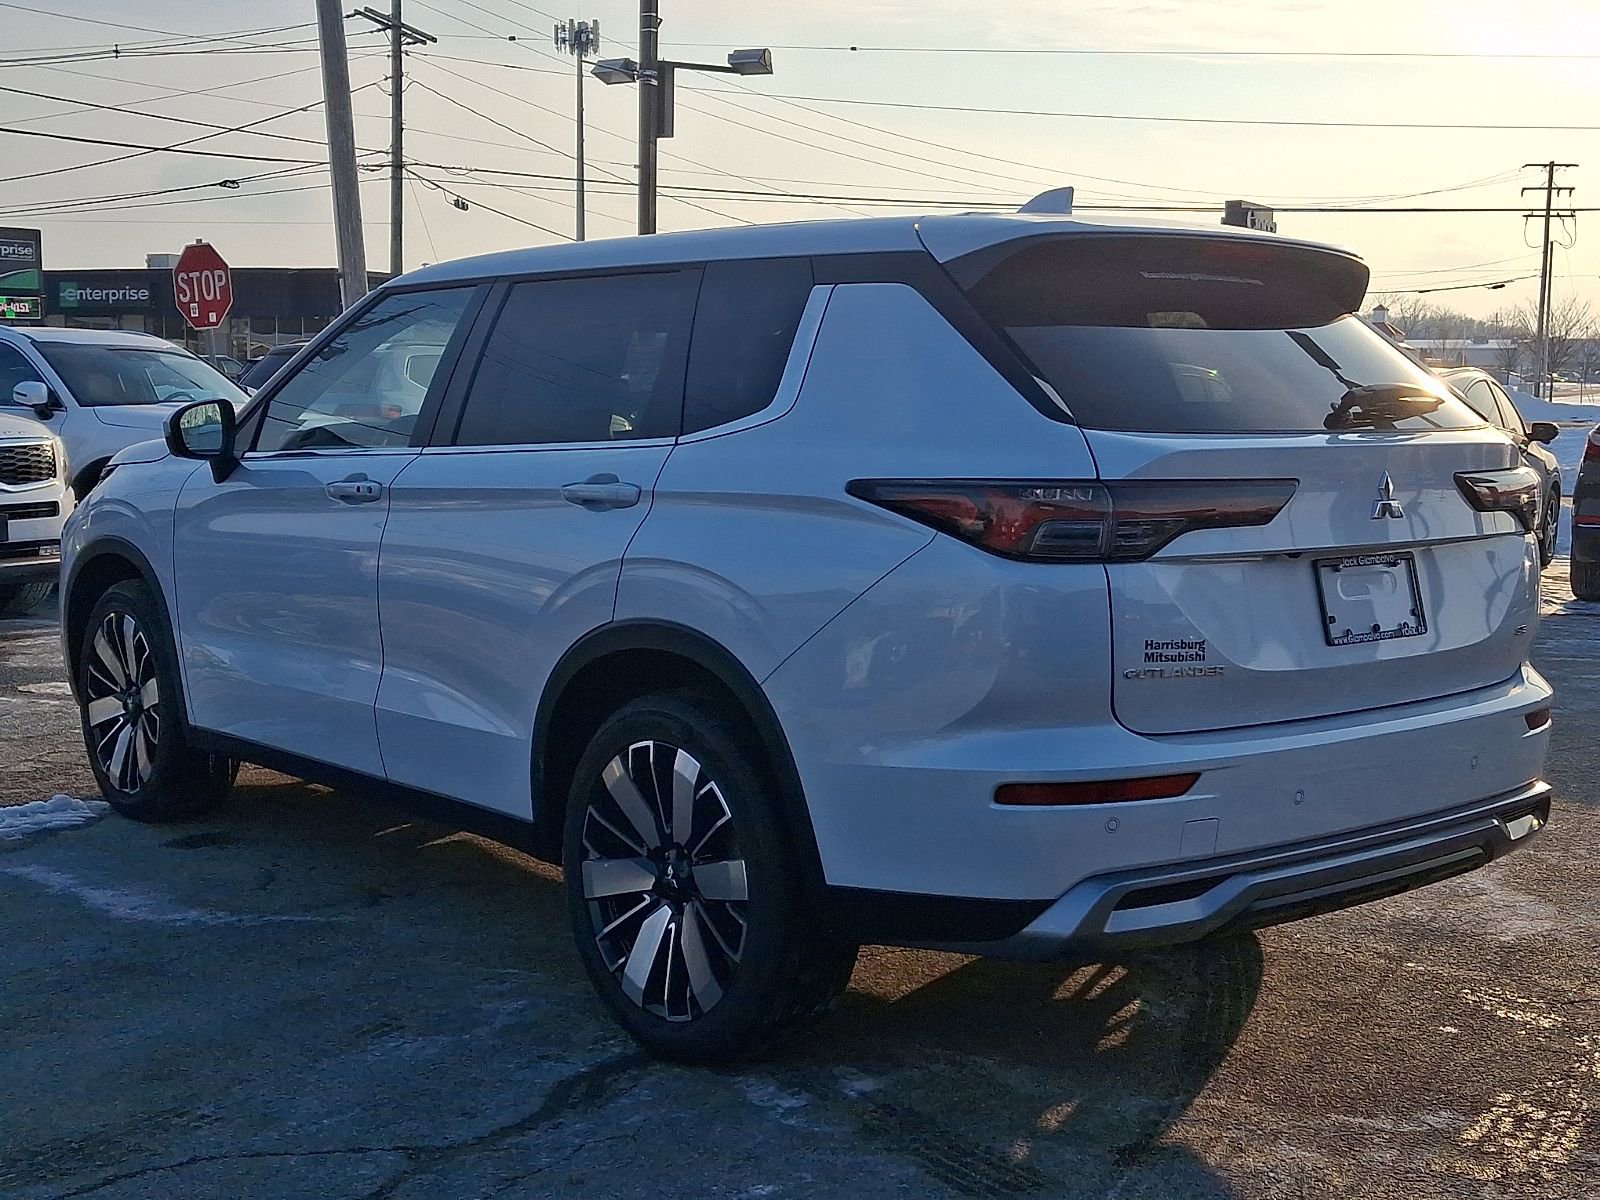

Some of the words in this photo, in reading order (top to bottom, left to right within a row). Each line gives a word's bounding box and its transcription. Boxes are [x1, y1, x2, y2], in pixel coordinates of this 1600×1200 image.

[0, 244, 33, 256] prise
[177, 269, 226, 303] STOP
[60, 285, 149, 304] enterprise
[1342, 556, 1358, 567] Jack
[1144, 639, 1206, 653] Harrisburg
[1144, 651, 1206, 663] Mitsubishi
[1123, 664, 1226, 679] OUTLANDER
